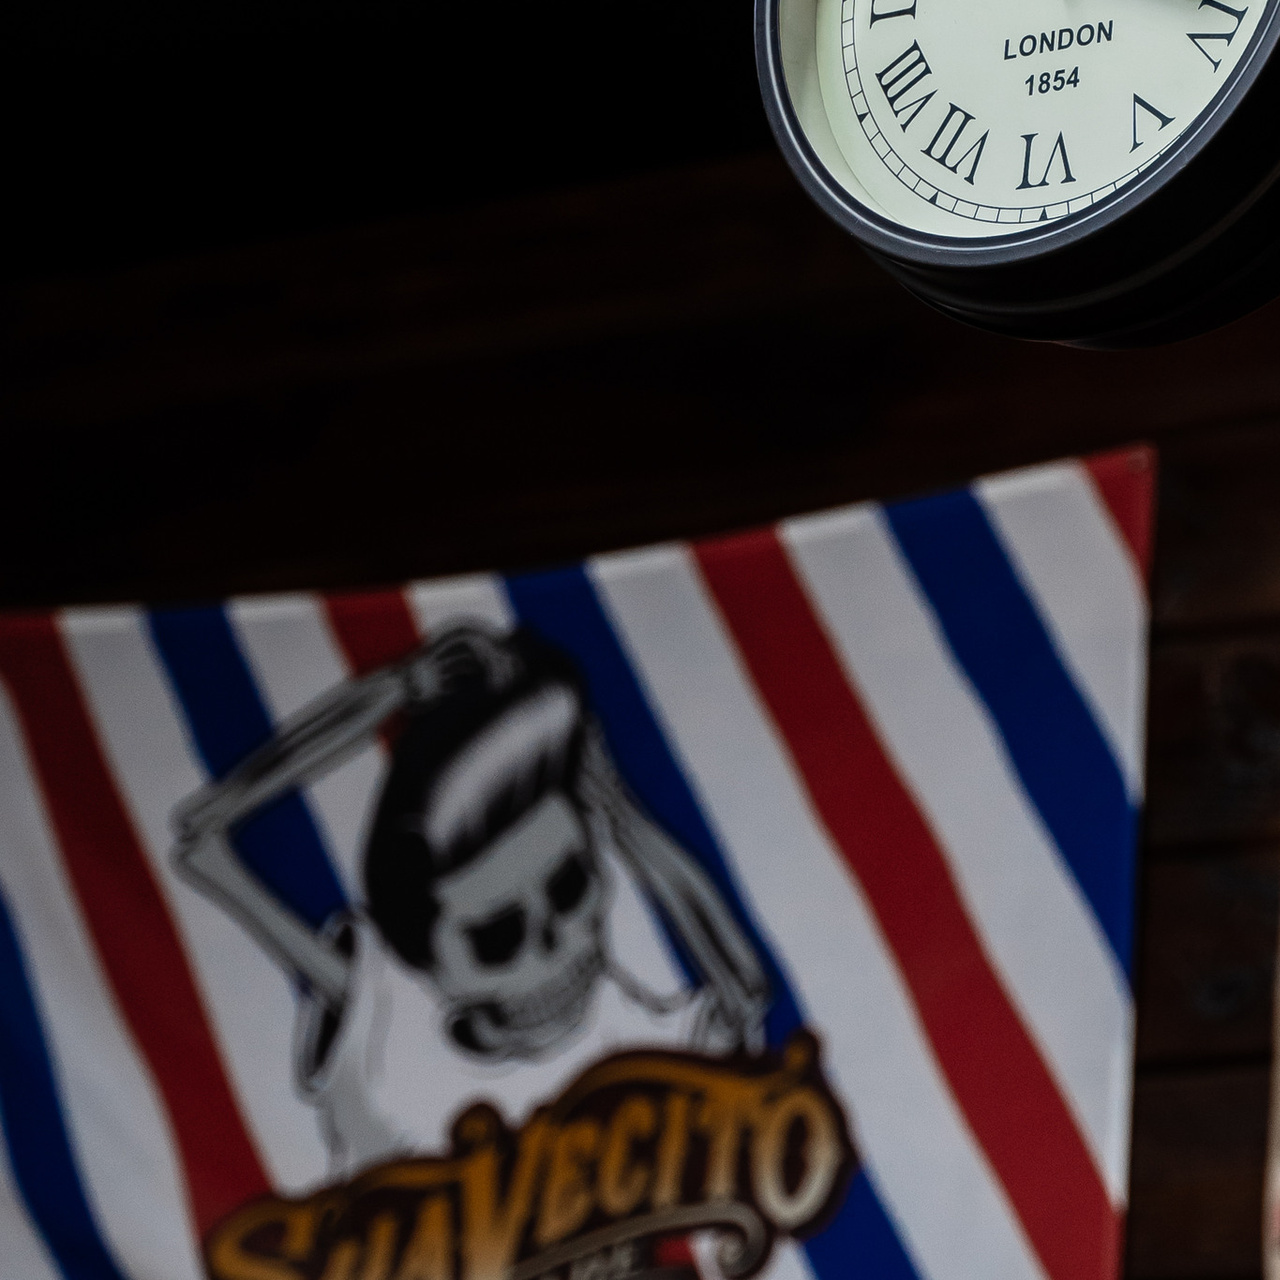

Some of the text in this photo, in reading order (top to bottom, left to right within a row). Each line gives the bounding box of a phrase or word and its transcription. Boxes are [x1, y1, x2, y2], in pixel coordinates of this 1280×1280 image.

[1003, 20, 1114, 61] LONDON
[875, 39, 936, 133] VIII
[1023, 66, 1081, 97] 1854
[920, 102, 989, 185] VII
[1129, 92, 1176, 154] V
[1016, 131, 1076, 190] VI
